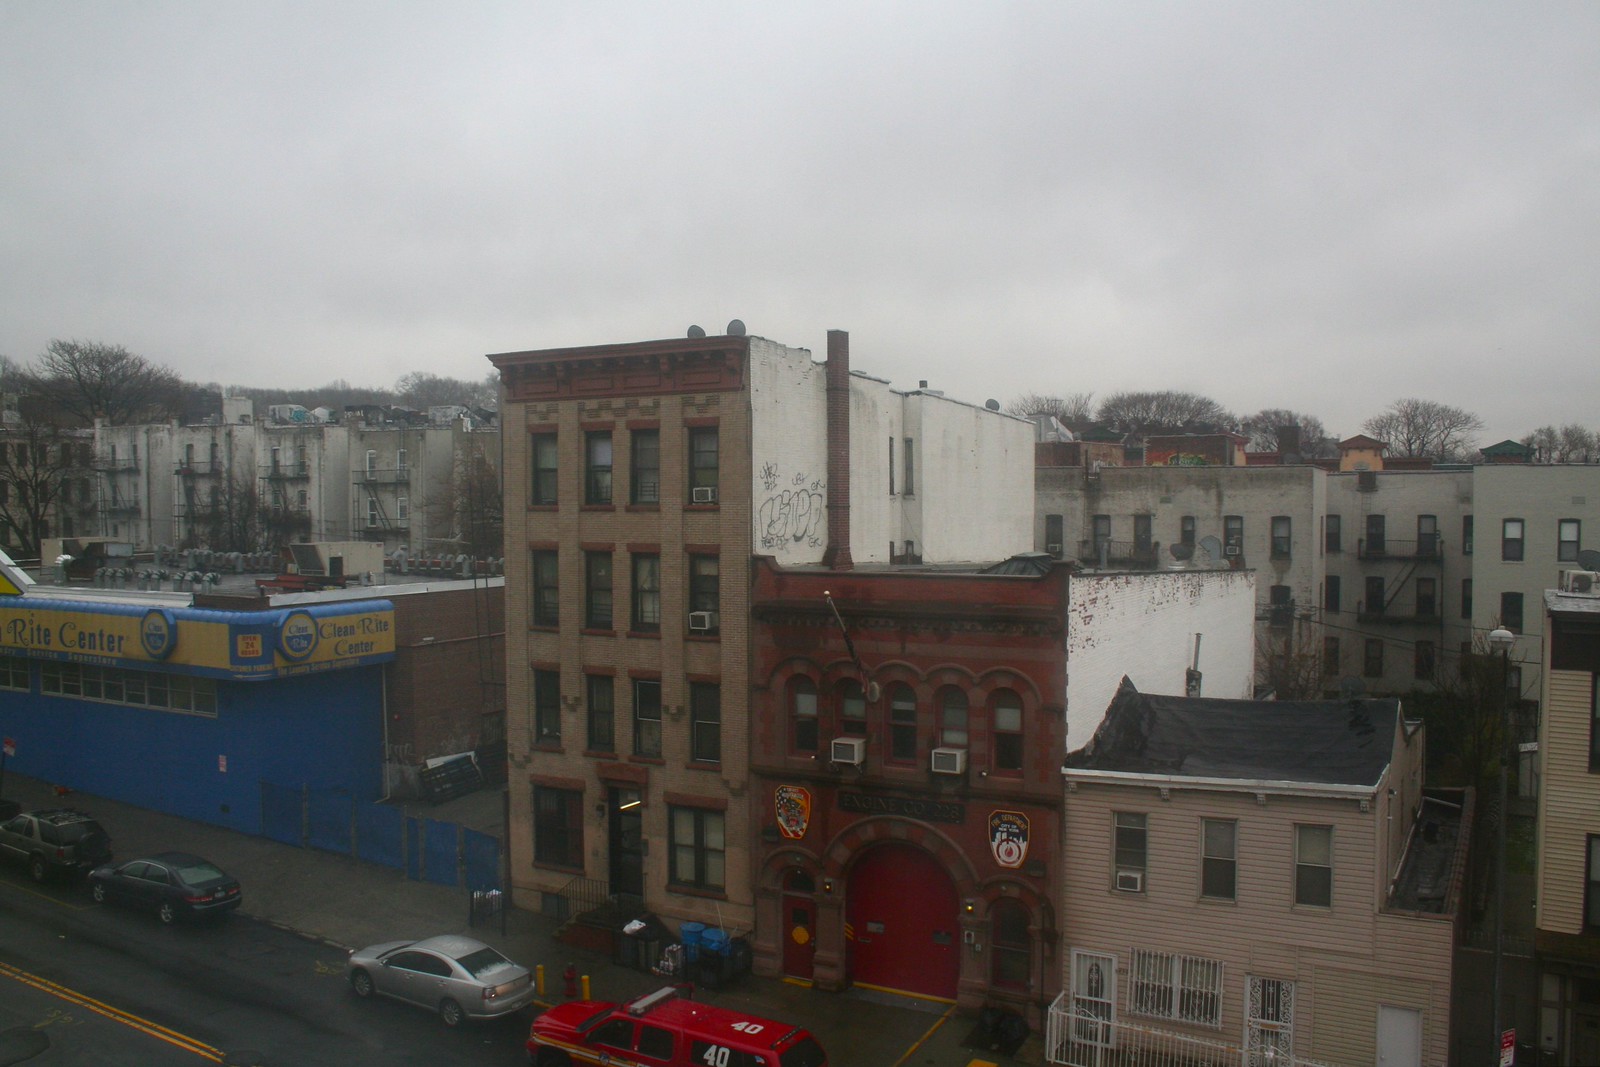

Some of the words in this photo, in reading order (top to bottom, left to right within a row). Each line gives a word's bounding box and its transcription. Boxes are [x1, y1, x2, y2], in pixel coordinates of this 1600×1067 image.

[7, 615, 51, 646] Rite
[59, 622, 124, 653] Center
[319, 623, 355, 639] Clean
[357, 616, 389, 634] Rite
[334, 639, 374, 656] Center
[842, 793, 897, 812] ENGINE
[730, 1021, 764, 1035] 40
[703, 1044, 730, 1067] 40
